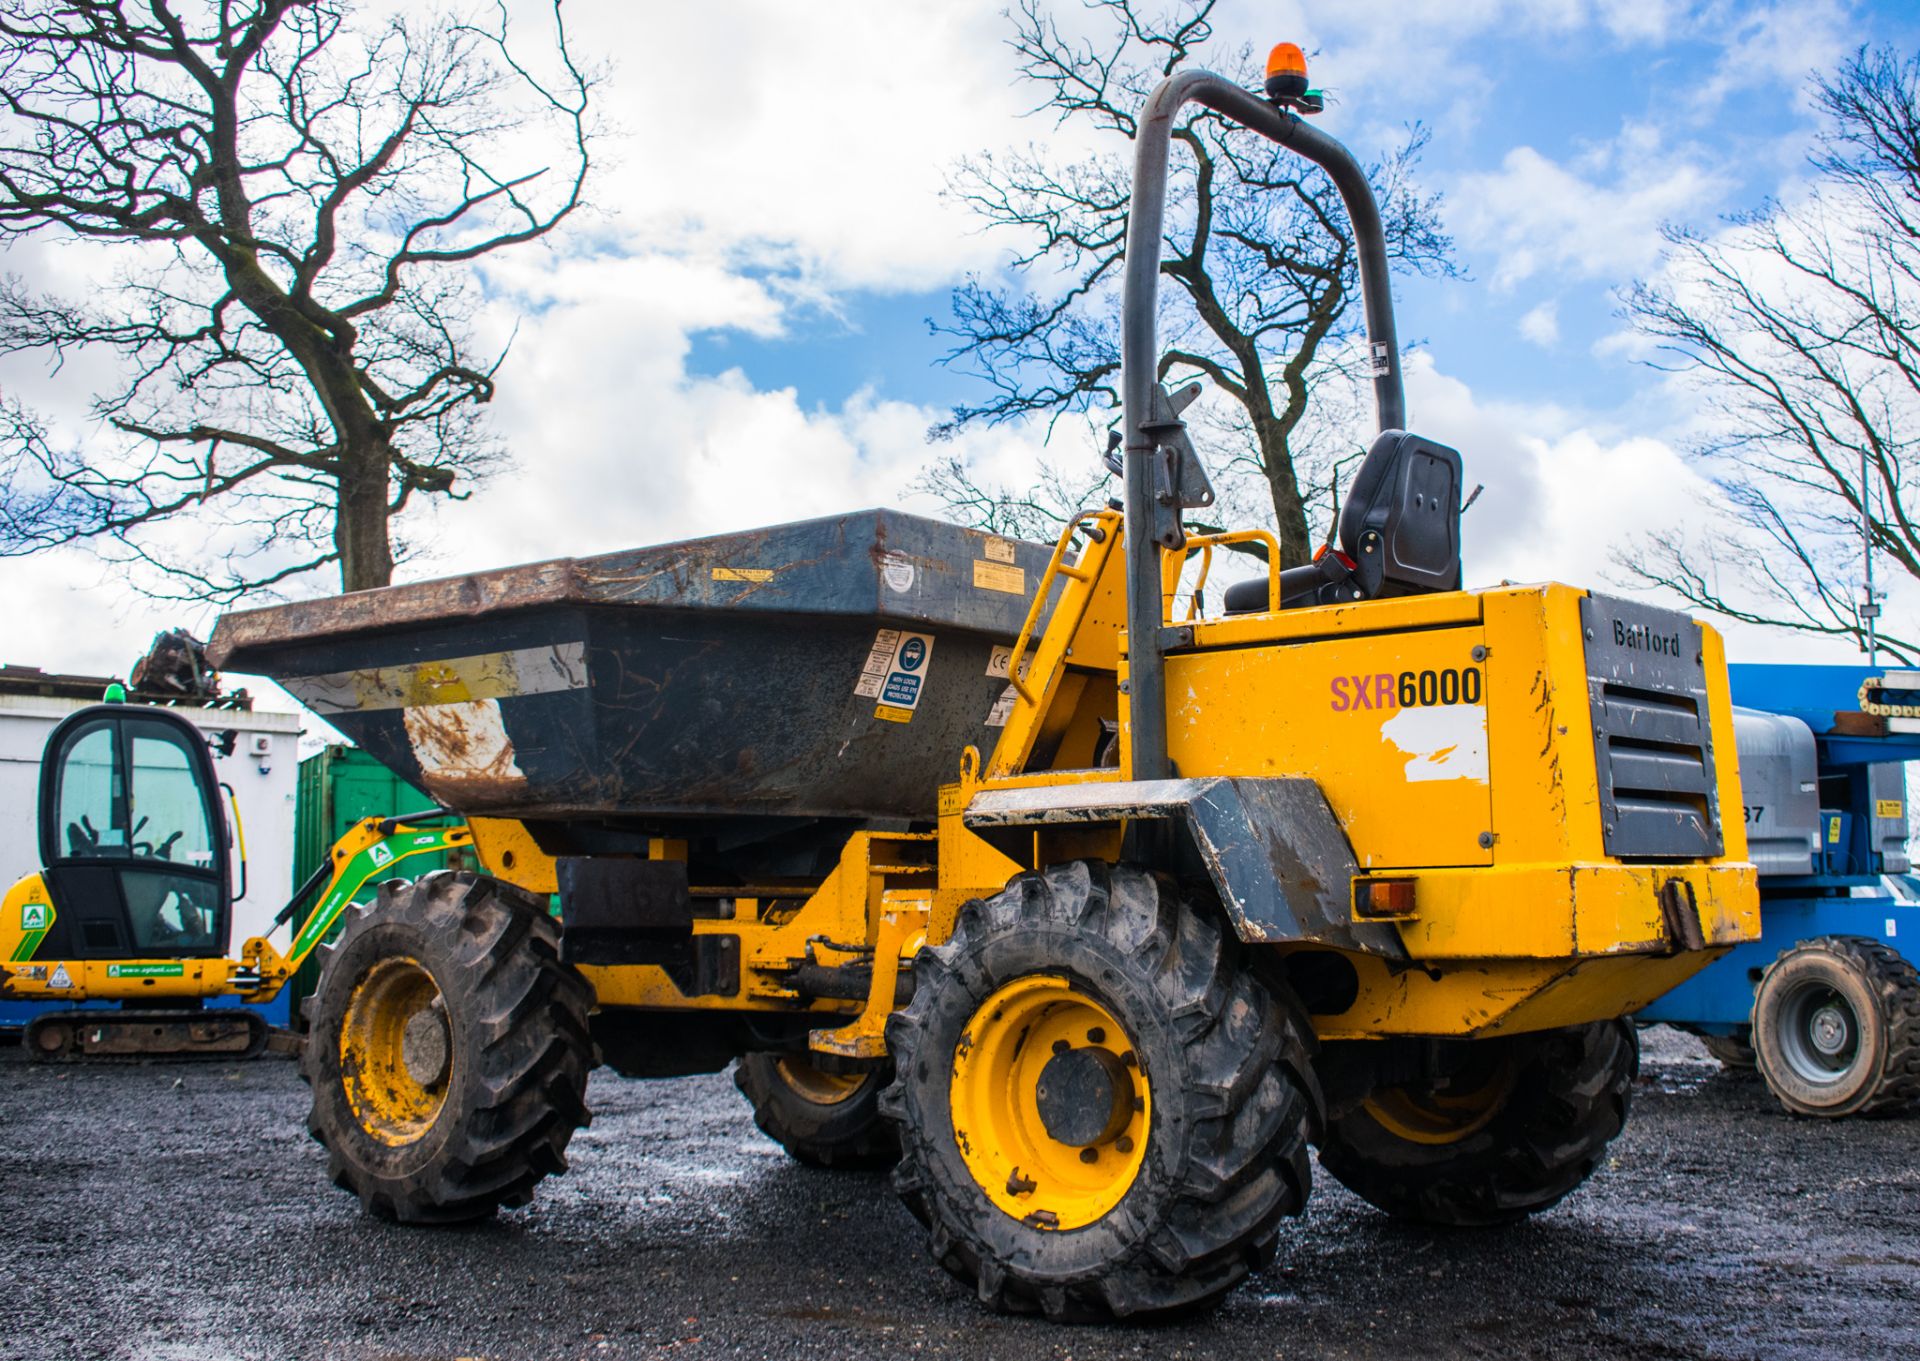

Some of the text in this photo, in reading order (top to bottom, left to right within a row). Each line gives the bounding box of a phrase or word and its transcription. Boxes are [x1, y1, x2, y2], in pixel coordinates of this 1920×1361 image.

[1613, 619, 1680, 658] Barford
[1330, 667, 1481, 712] SXR6000
[27, 908, 42, 921] A
